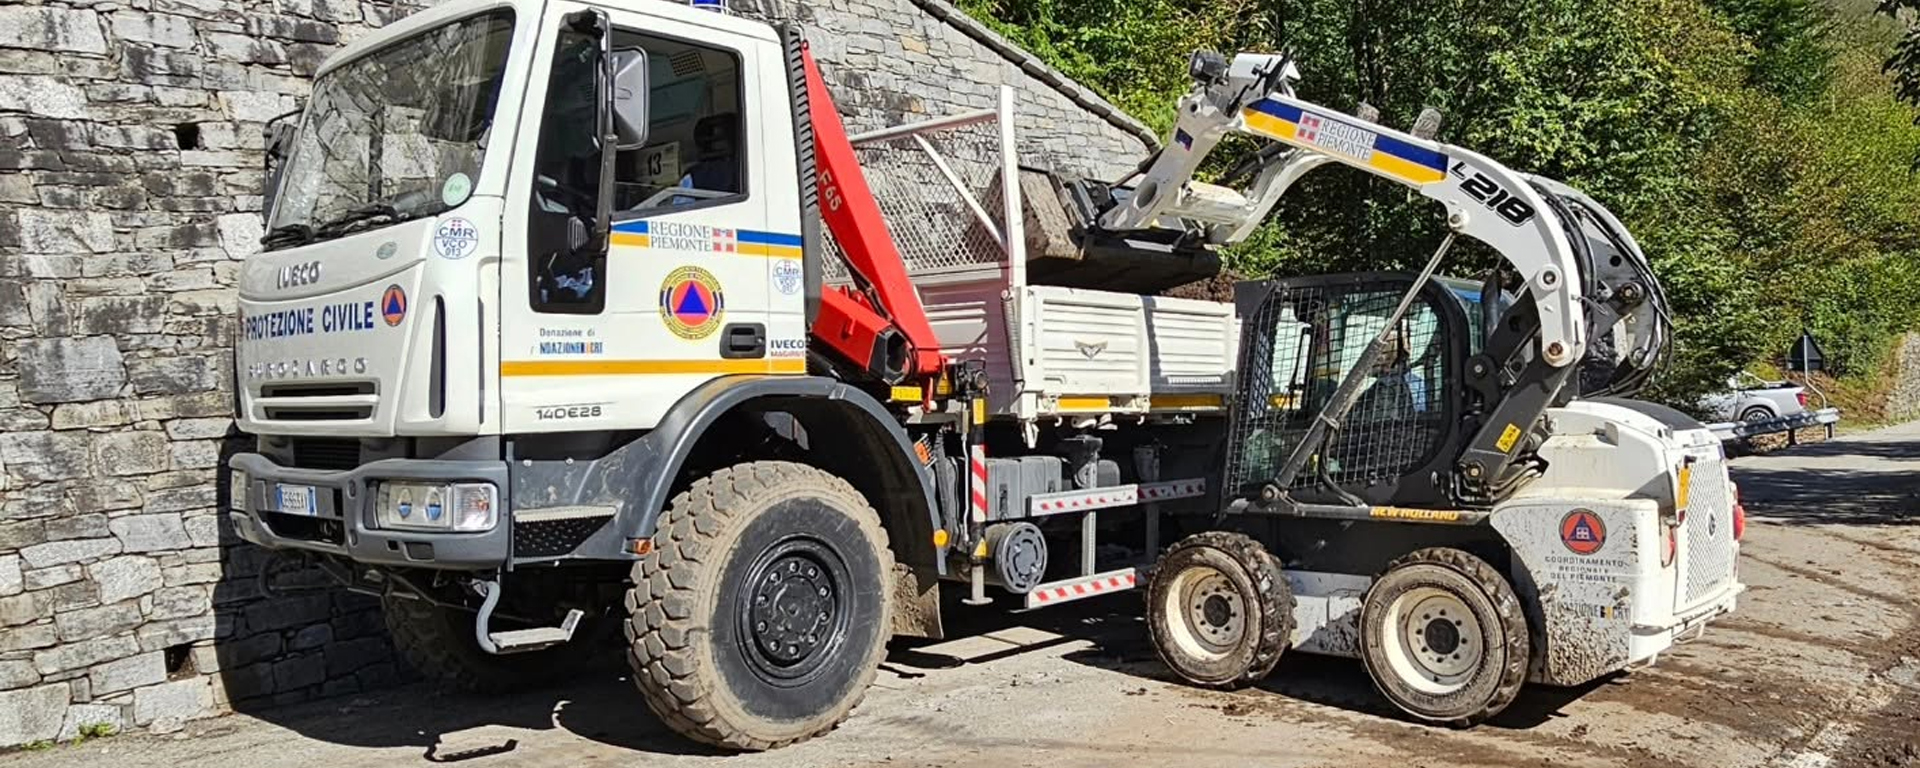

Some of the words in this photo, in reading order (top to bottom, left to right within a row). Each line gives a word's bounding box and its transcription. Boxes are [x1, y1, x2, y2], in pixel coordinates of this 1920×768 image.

[1321, 121, 1376, 148] REGIONE
[1316, 133, 1371, 161] PIEMONTE
[439, 226, 475, 238] CMR
[650, 220, 711, 240] REGIONE
[441, 239, 468, 249] VCO
[650, 236, 712, 253] PIEMONTE
[277, 261, 321, 290] IVECO
[775, 267, 800, 277] CMR
[246, 308, 314, 340] PROTEZIONE
[322, 301, 375, 333] CIVILE
[540, 328, 582, 337] Donazione
[587, 328, 596, 337] di
[770, 339, 805, 349] IVECO
[536, 406, 603, 420] 140E28
[1369, 506, 1399, 518] NEW
[1400, 507, 1460, 521] HOLLAND
[1544, 556, 1624, 568] COORDINAMENTO
[1550, 572, 1567, 581] DEL
[1570, 573, 1617, 584] PIEMONTE
